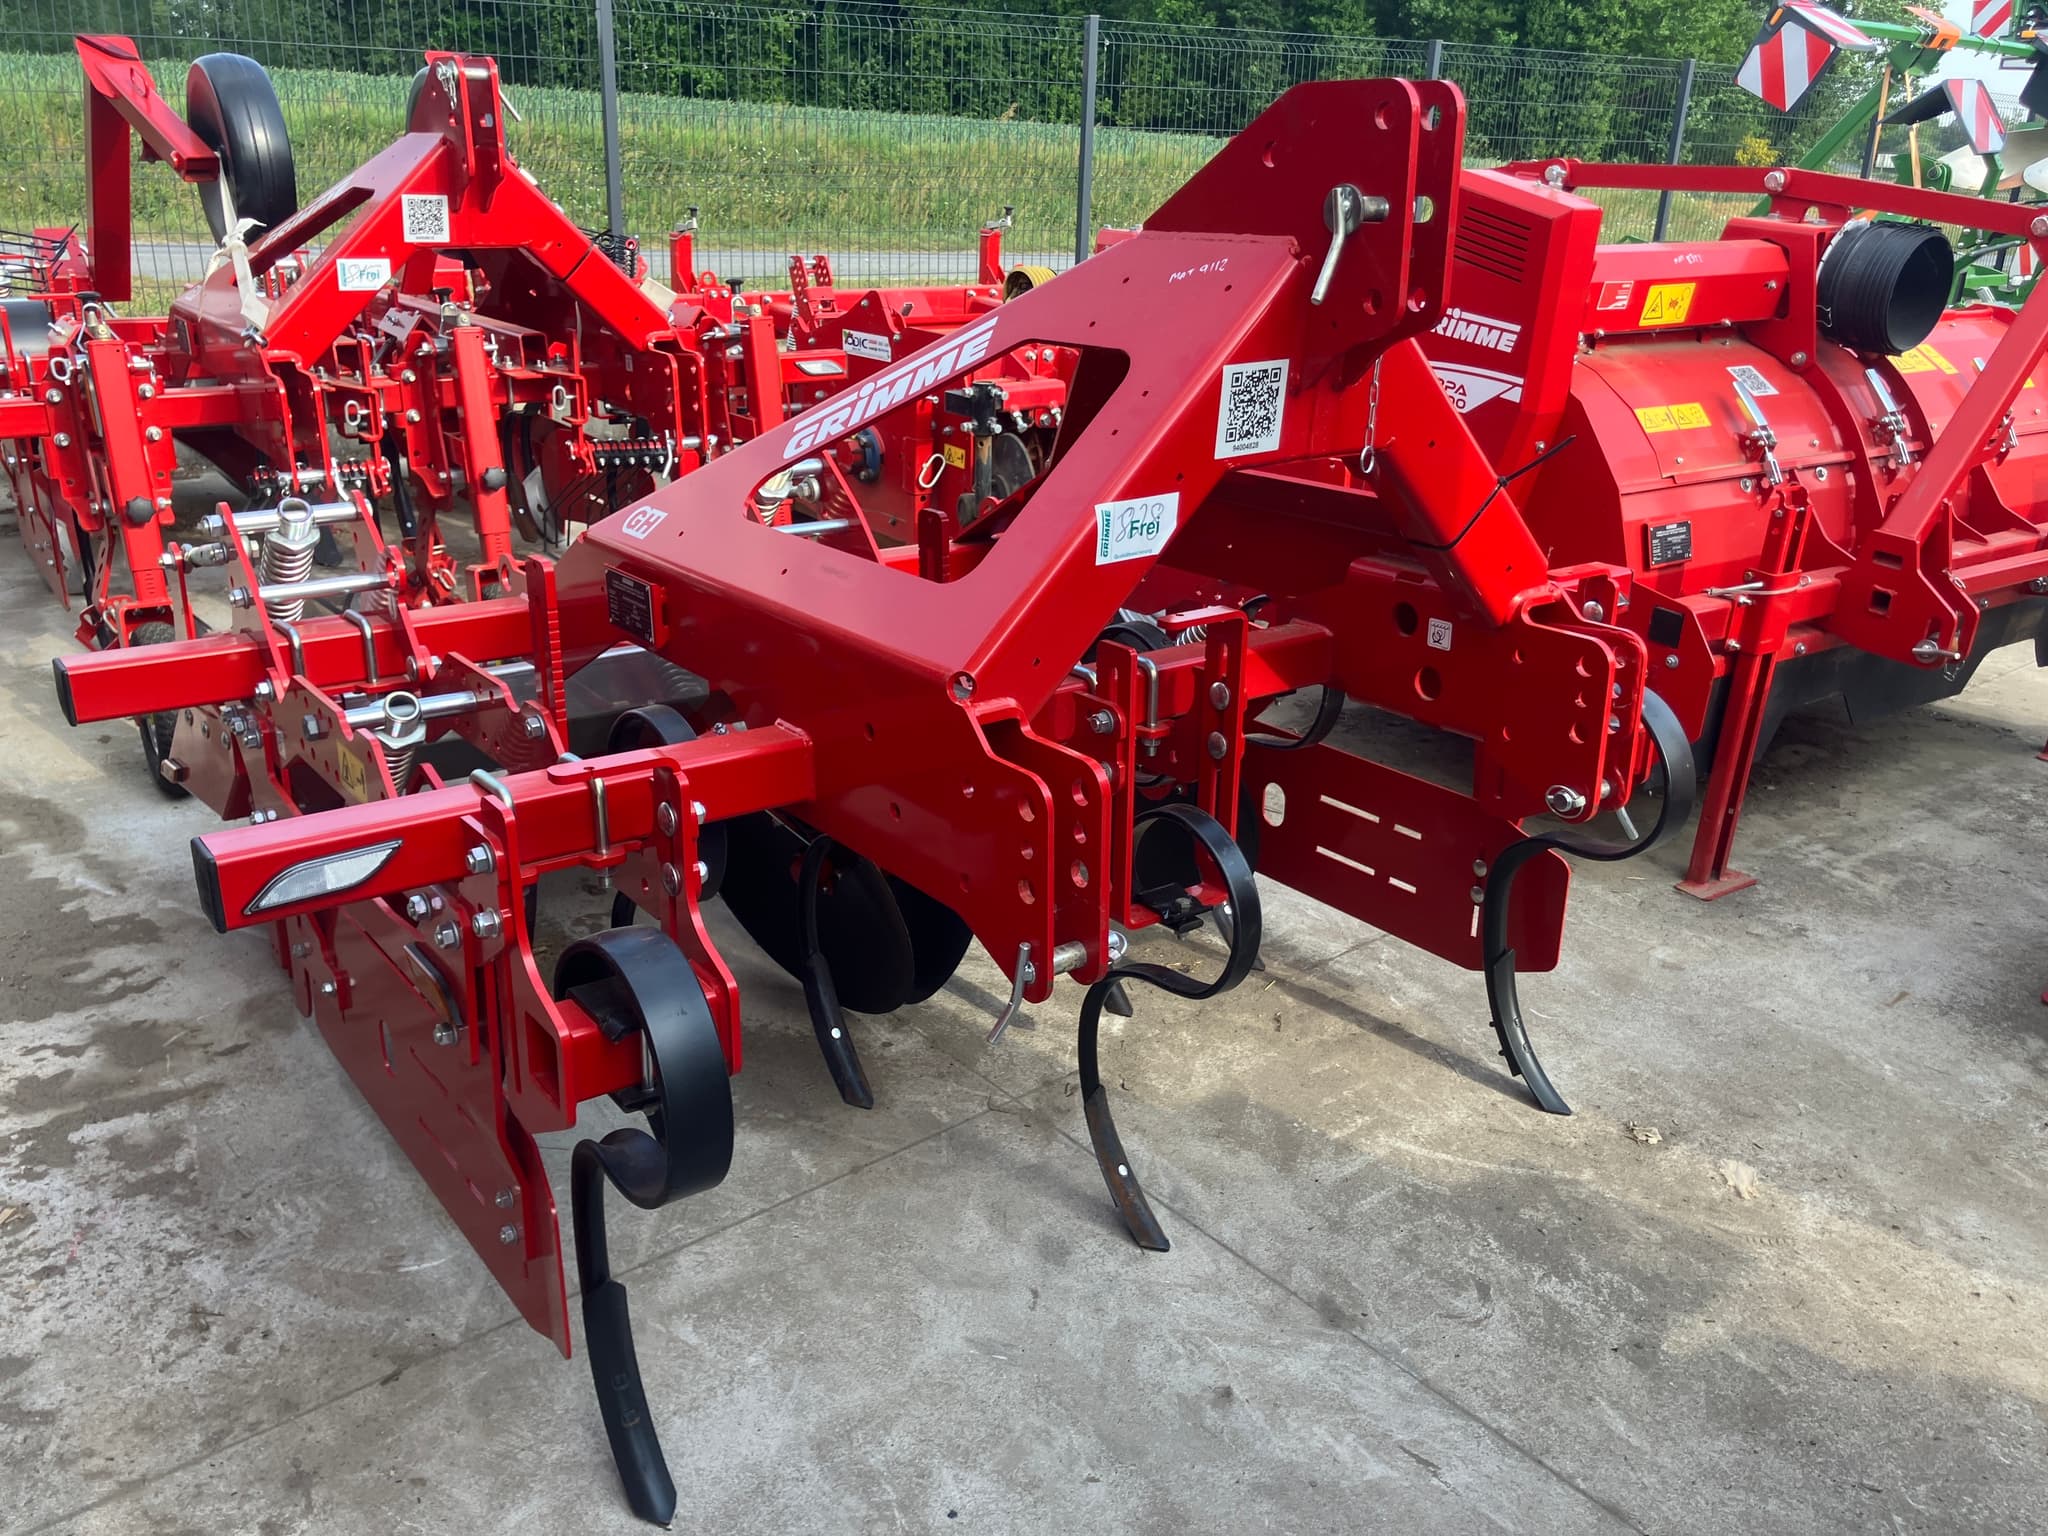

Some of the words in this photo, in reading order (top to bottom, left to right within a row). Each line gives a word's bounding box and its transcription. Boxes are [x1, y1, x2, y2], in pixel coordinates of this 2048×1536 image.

[1430, 307, 1521, 353] RIMME
[783, 315, 999, 460] GRIMME
[1101, 509, 1112, 558] GRIMME
[1128, 515, 1161, 540] Frei
